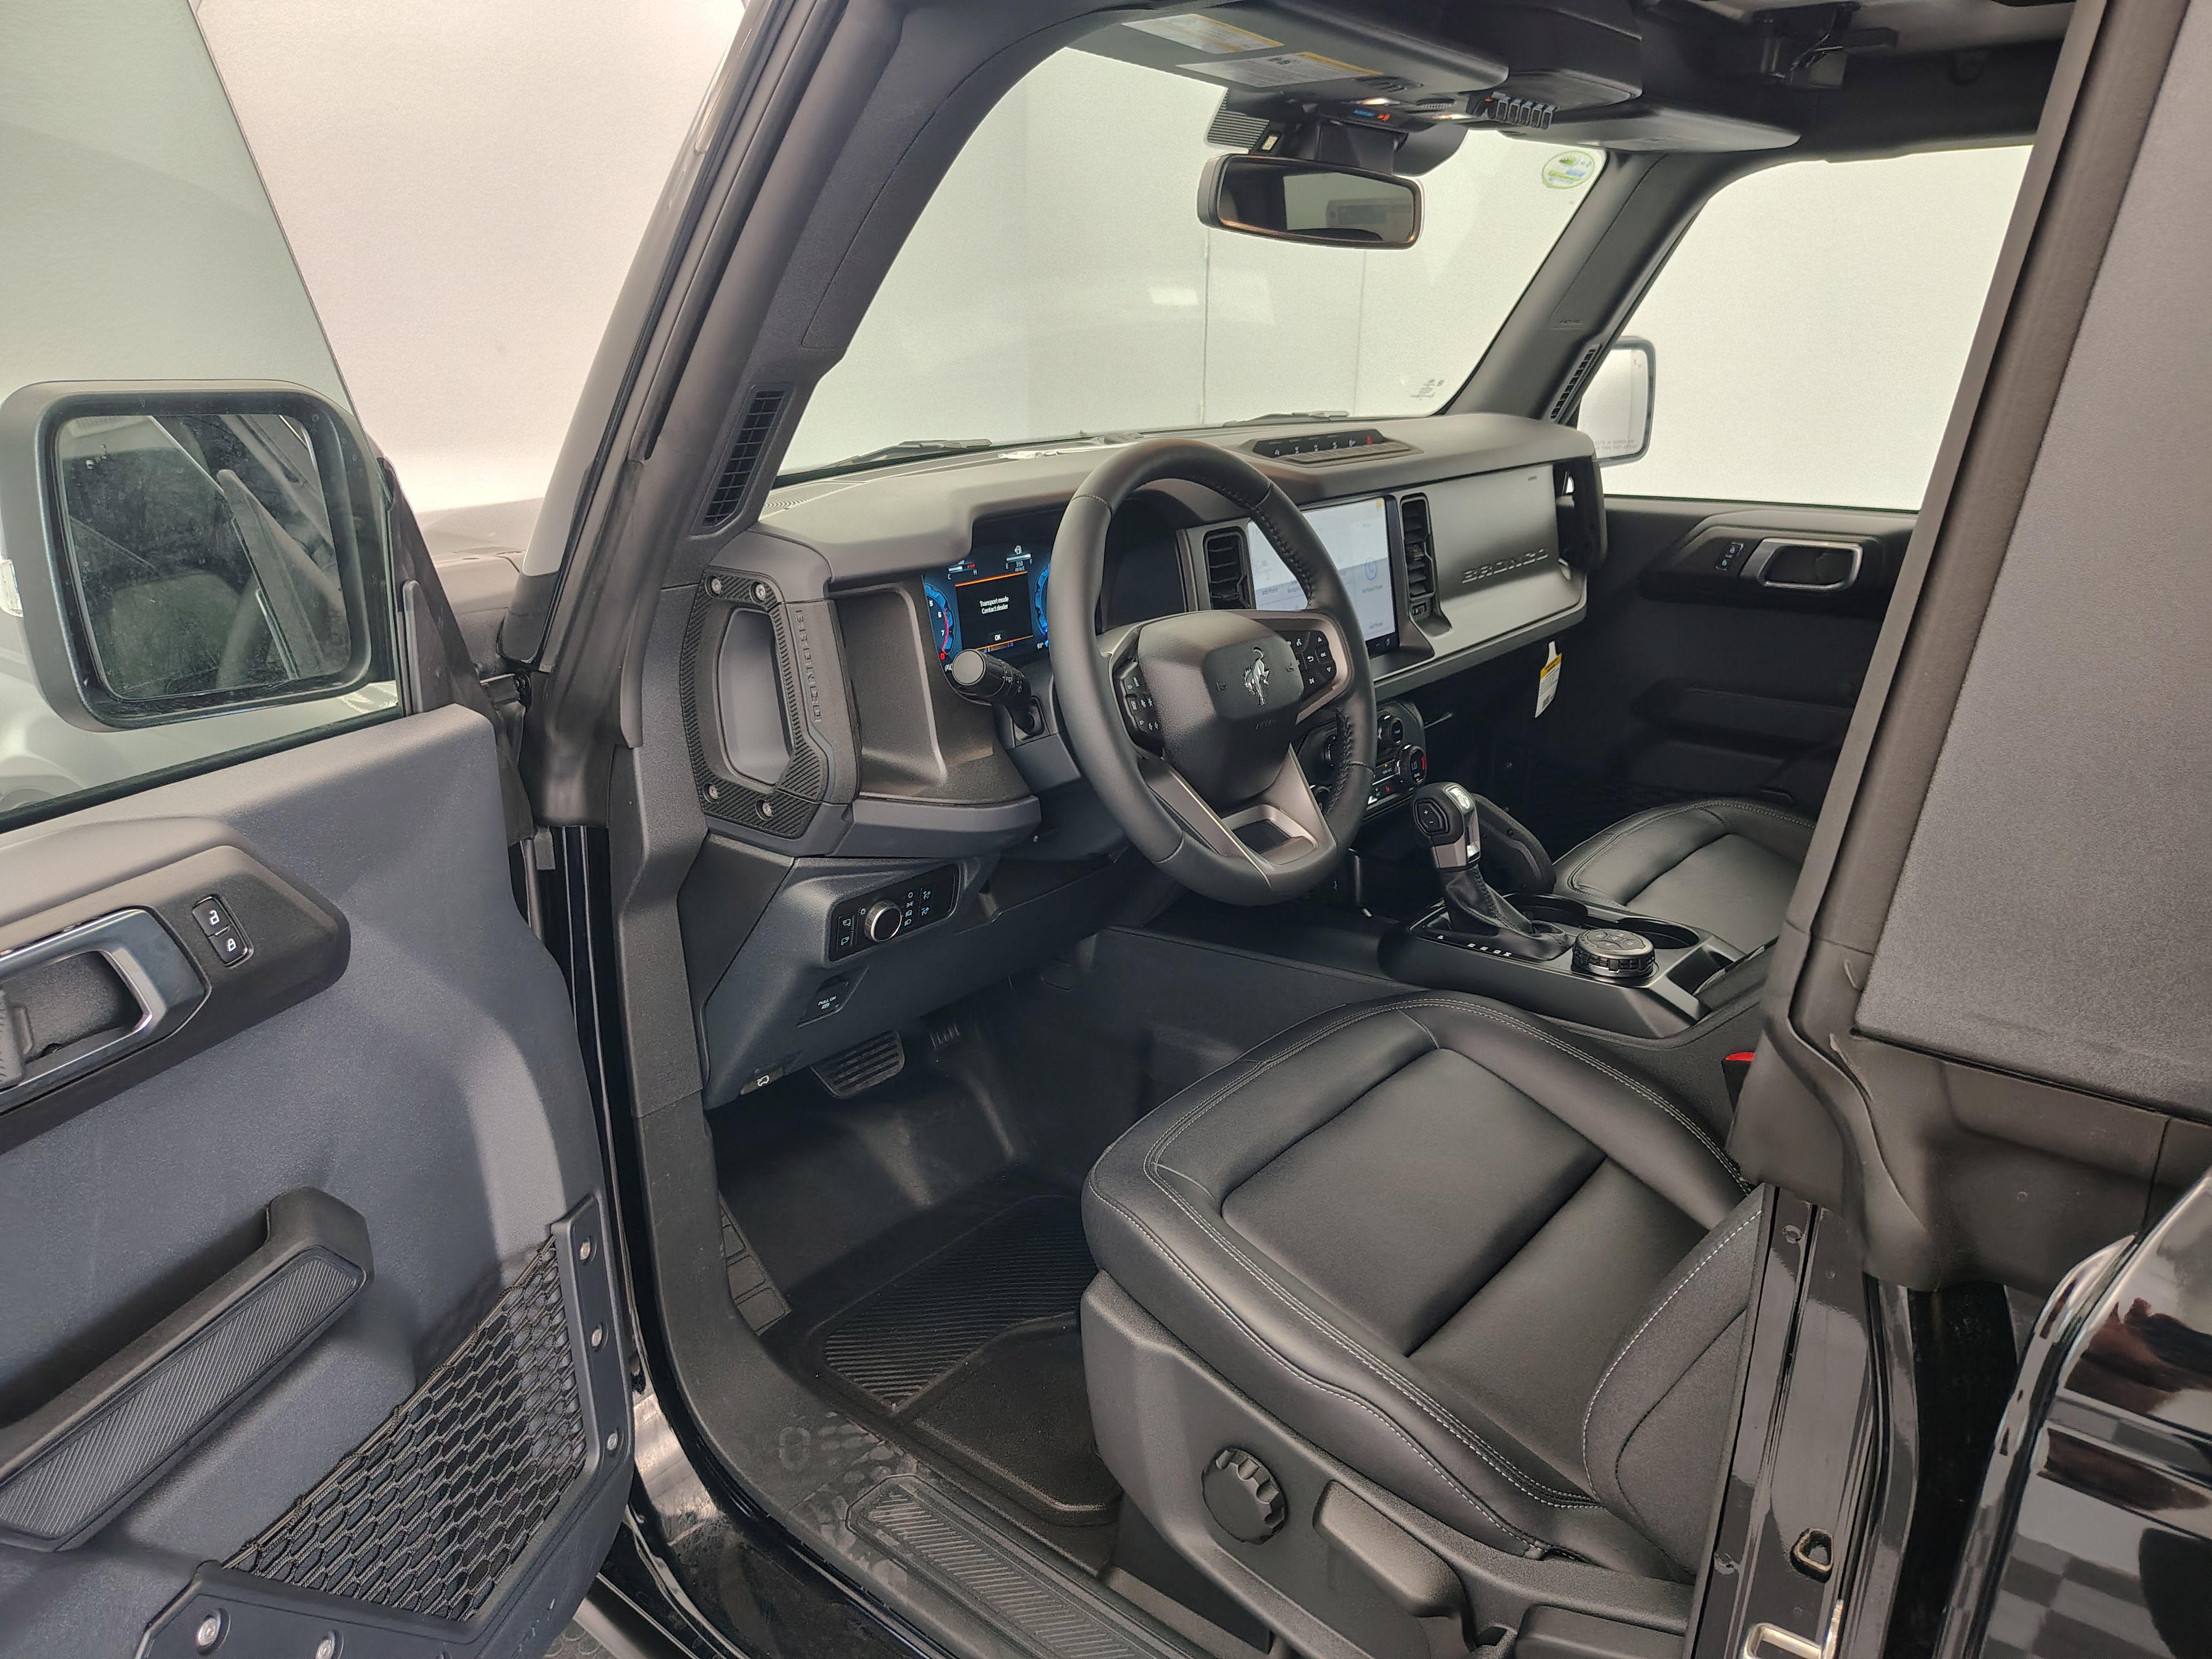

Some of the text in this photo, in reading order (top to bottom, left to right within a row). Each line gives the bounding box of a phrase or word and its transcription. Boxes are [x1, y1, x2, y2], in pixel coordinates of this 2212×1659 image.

[1461, 549, 1549, 584] BRONCO
[980, 596, 1009, 606] Transport mode
[982, 604, 1008, 614] Contact dealer
[796, 610, 822, 723] BRONCO
